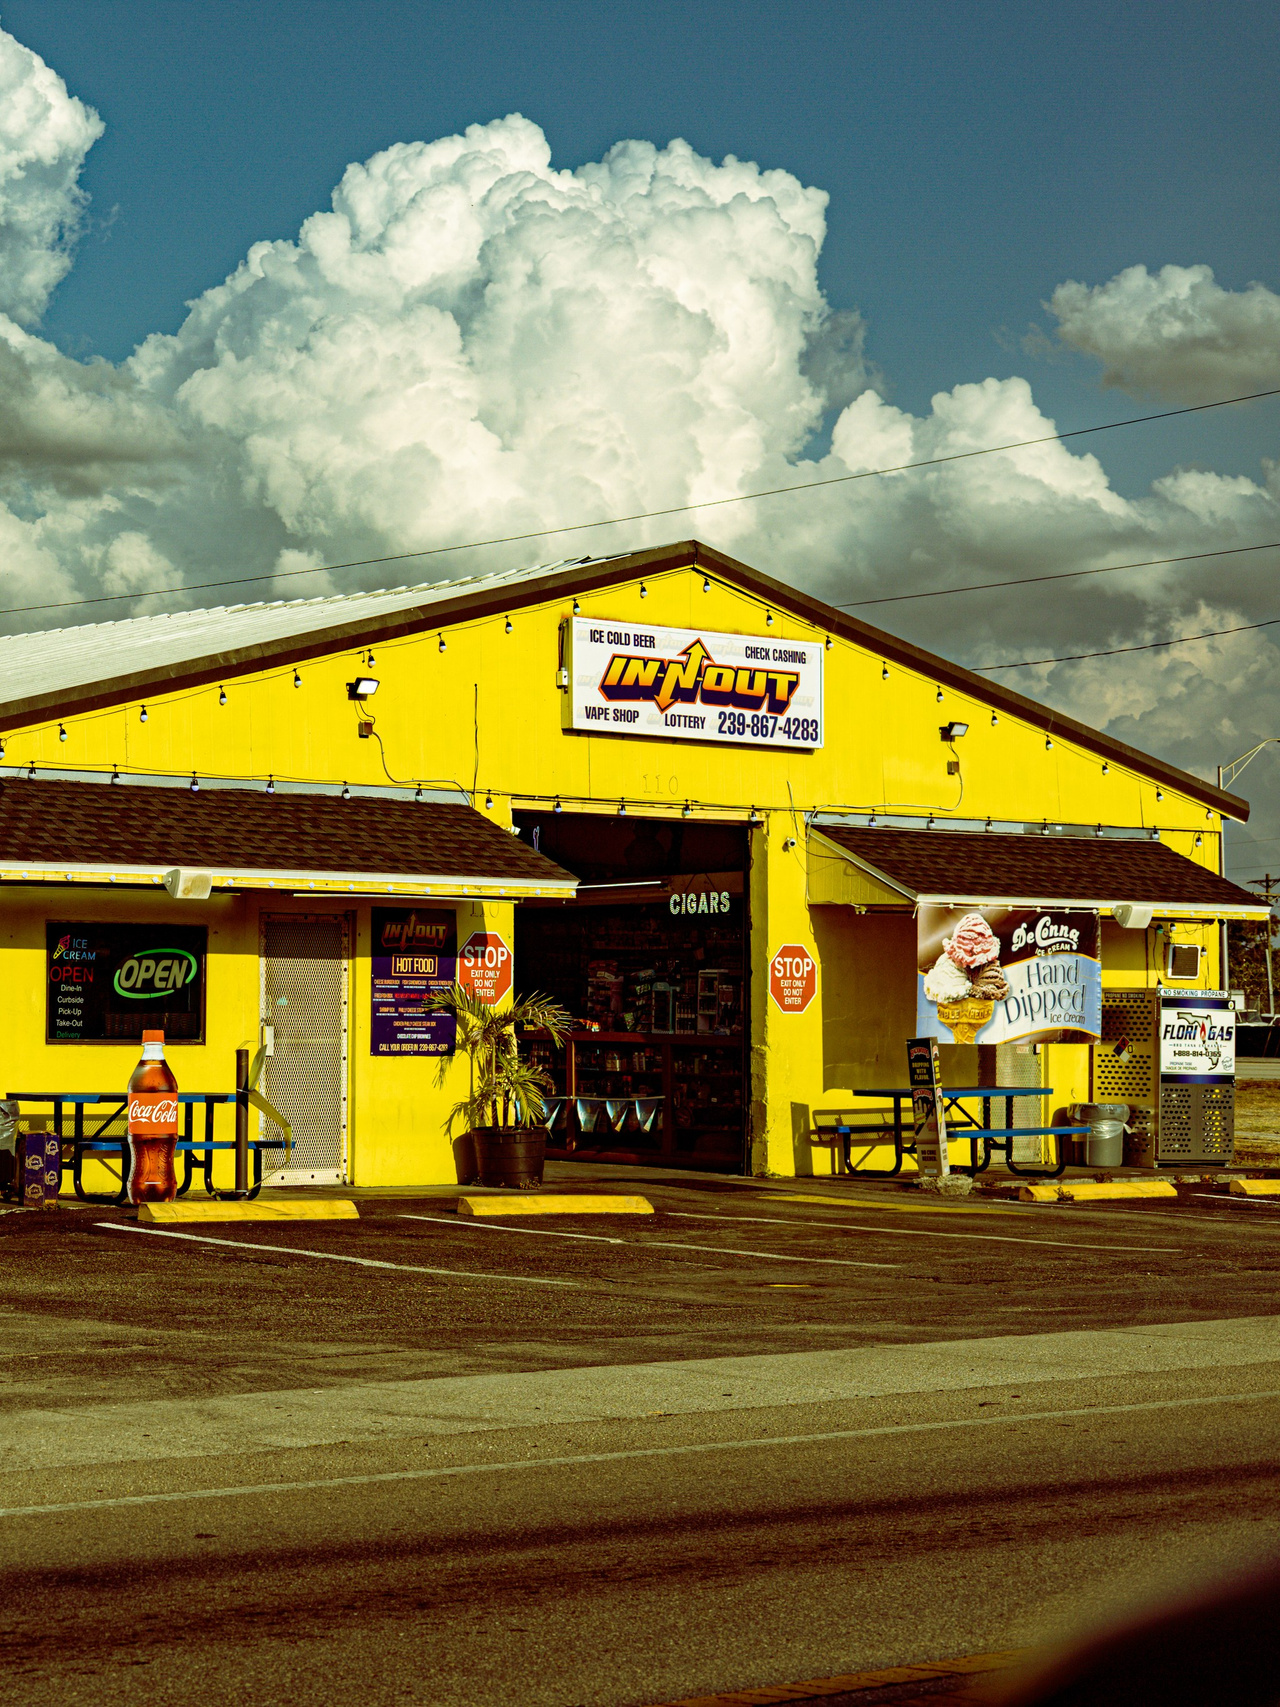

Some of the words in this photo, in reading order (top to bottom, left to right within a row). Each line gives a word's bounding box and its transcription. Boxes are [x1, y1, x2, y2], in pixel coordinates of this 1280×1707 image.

[589, 629, 606, 644] ICE
[607, 631, 630, 647] COLD
[633, 634, 656, 649] BEER
[745, 645, 770, 661] CHECK
[772, 648, 806, 664] CASHING
[585, 706, 611, 721] VAPE
[612, 708, 640, 723] SHOP
[664, 713, 706, 730] LOTTERY
[718, 711, 819, 742] 239-867-4283
[643, 774, 679, 795] 110
[669, 891, 731, 915] CIGARS
[73, 938, 88, 949] ICE
[1035, 947, 1046, 956] ICE
[1048, 943, 1070, 955] CREAM
[62, 951, 96, 961] CREAM
[464, 945, 508, 968] STOP
[396, 957, 413, 973] HOT
[414, 957, 434, 973] FOOD
[774, 956, 813, 978] STOP
[50, 966, 94, 983] OPEN
[120, 959, 189, 989] OPEN
[470, 969, 484, 978] EXIT
[484, 970, 500, 979] ONLY
[1027, 959, 1079, 988] Hand
[60, 984, 82, 992] Dine-In
[474, 979, 484, 987] DO
[780, 980, 792, 988] EXIT
[792, 980, 806, 988] ONLY
[784, 988, 791, 996] DO
[792, 988, 803, 996] NOT
[1200, 990, 1226, 998] PROPANE
[784, 997, 802, 1005] ENTER
[1004, 985, 1086, 1024] Dipped
[58, 1008, 82, 1016] Pick-Up
[1050, 1013, 1062, 1023] Ice
[1064, 1013, 1086, 1024] Cream
[56, 1019, 83, 1027] Take-Out
[56, 1031, 80, 1039] Delivery
[1163, 1024, 1198, 1040] FLORI
[1208, 1025, 1234, 1041] GAS
[379, 1044, 390, 1052] CALL
[390, 1044, 400, 1052] YOUR
[401, 1044, 413, 1052] ORDER
[1127, 1044, 1133, 1053] 0
[129, 1100, 178, 1123] Coca-Cola
